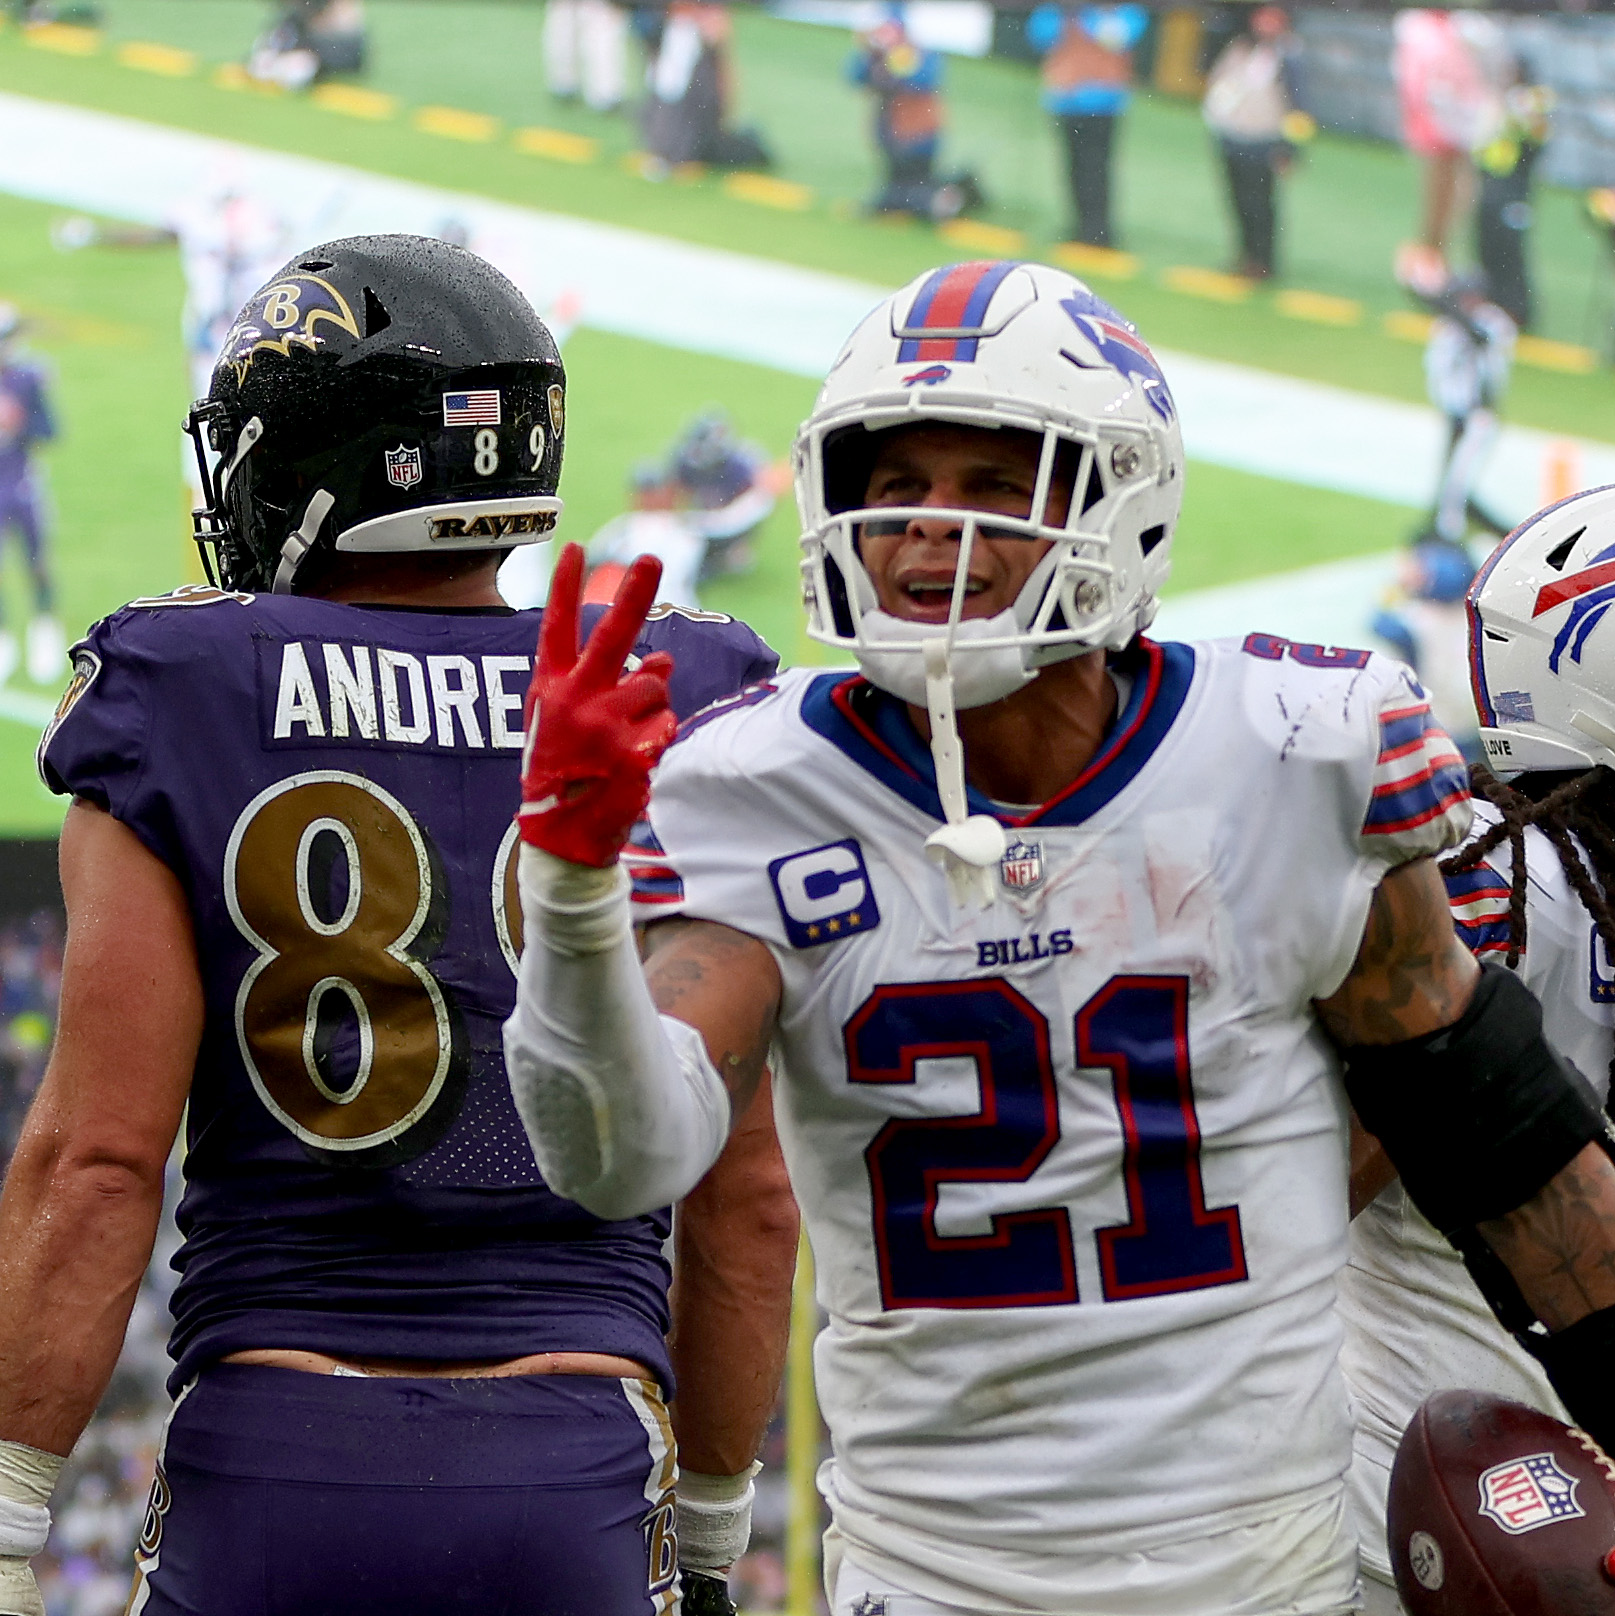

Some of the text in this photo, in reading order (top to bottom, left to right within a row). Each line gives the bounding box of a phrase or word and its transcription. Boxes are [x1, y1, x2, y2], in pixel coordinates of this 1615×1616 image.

[427, 509, 558, 540] RAVENS
[273, 642, 642, 748] ANDRE
[1486, 740, 1512, 756] LOVE
[778, 847, 865, 923] C
[1005, 860, 1039, 886] NFL
[223, 769, 525, 1151] 8
[977, 929, 1074, 967] BILLS
[842, 975, 1249, 1312] 21
[1489, 1466, 1543, 1525] NFL
